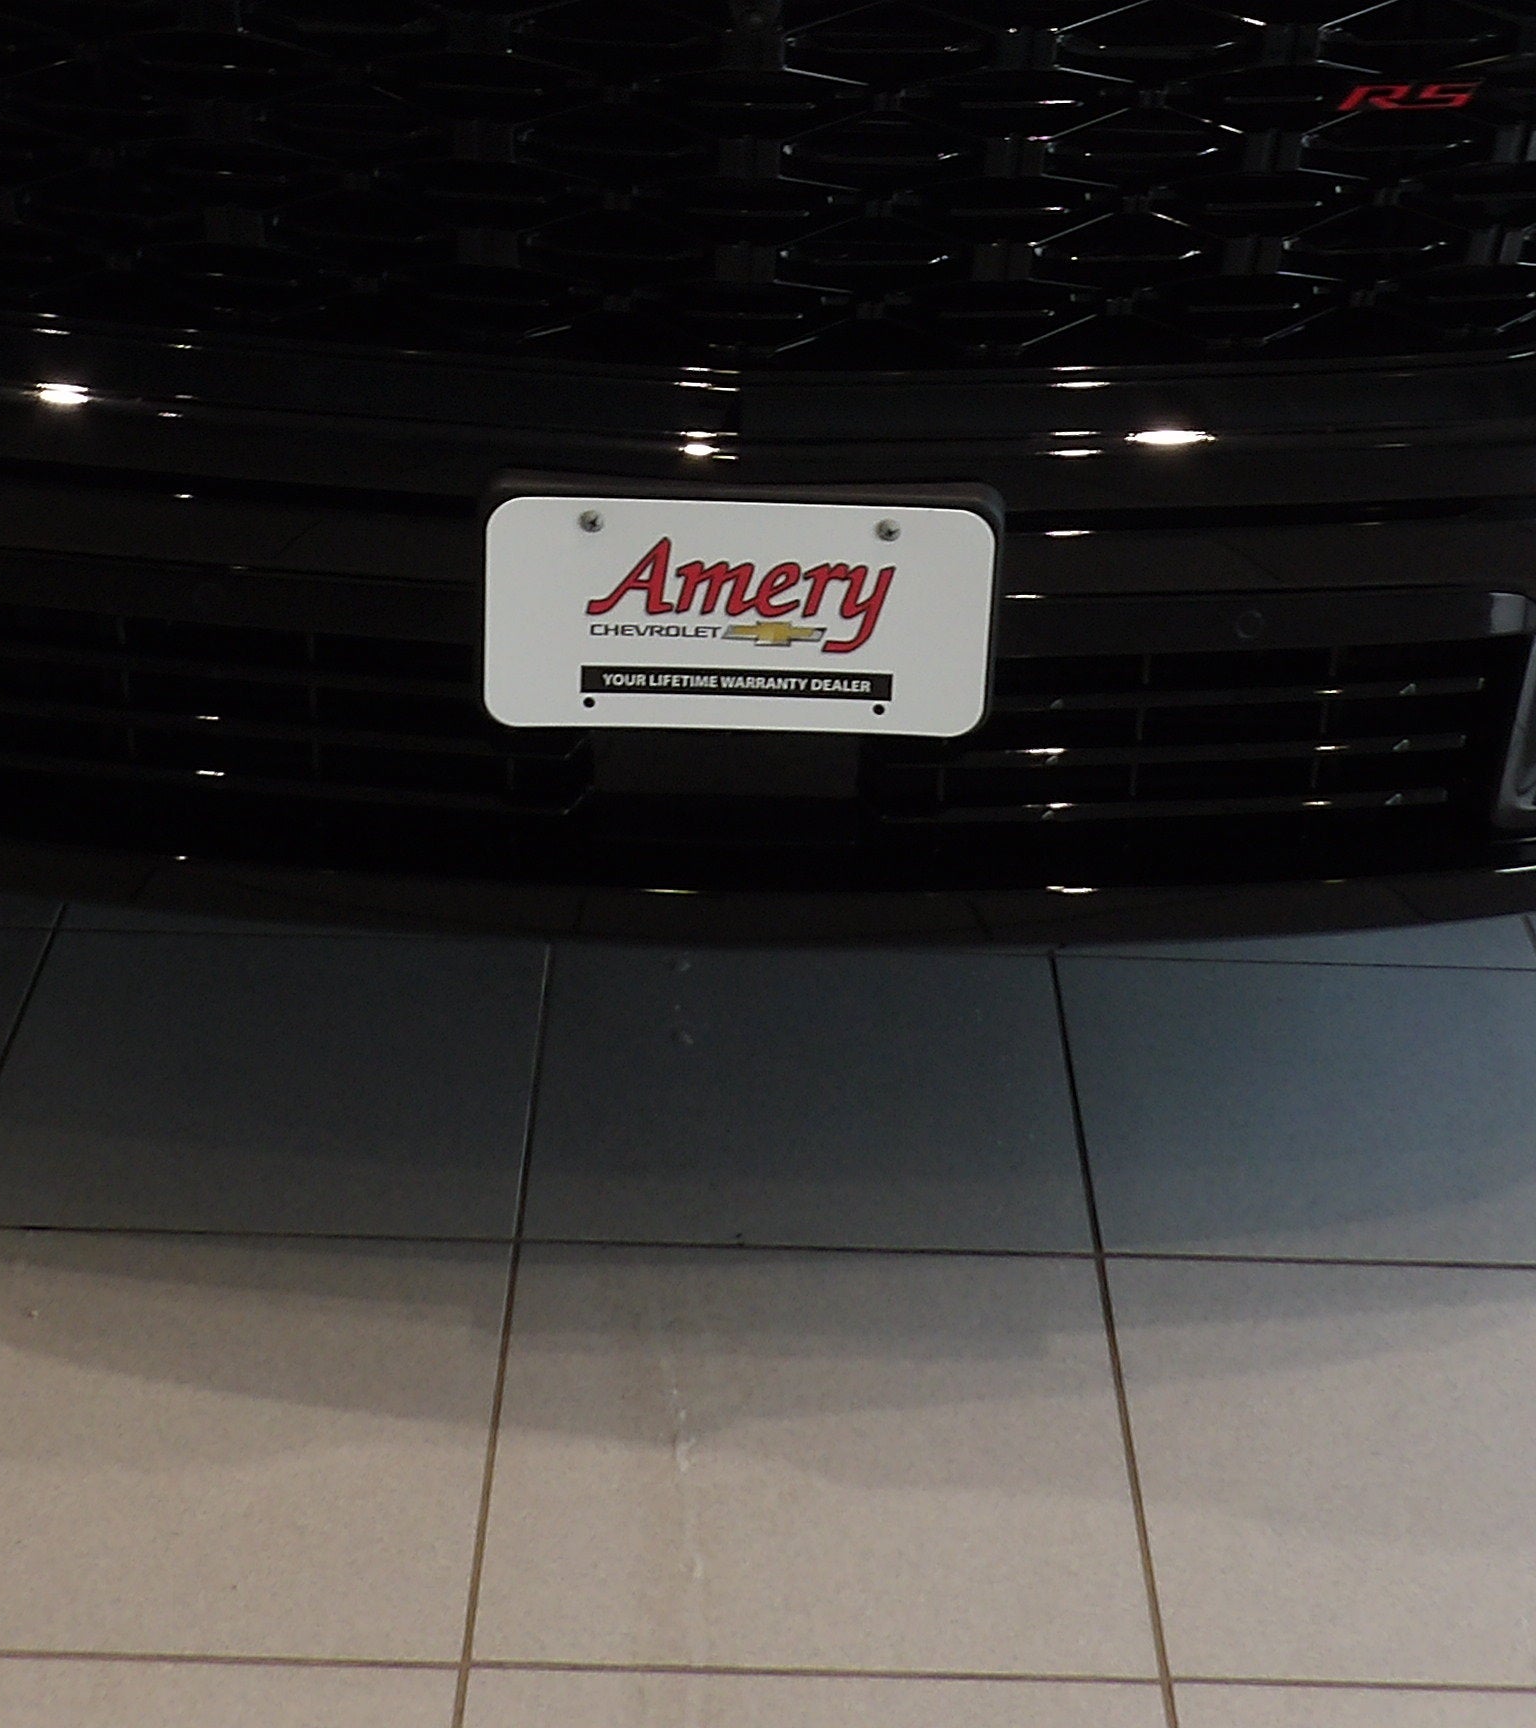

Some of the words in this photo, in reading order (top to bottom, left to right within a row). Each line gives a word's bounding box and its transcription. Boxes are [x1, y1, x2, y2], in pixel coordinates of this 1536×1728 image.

[1337, 83, 1481, 112] RS
[586, 537, 896, 653] Amery
[590, 624, 722, 638] CHEVROLET
[602, 673, 646, 686] YOUR
[649, 674, 718, 688] LIFETIME
[720, 676, 808, 691] WARRANTY
[810, 678, 871, 692] DEALER
